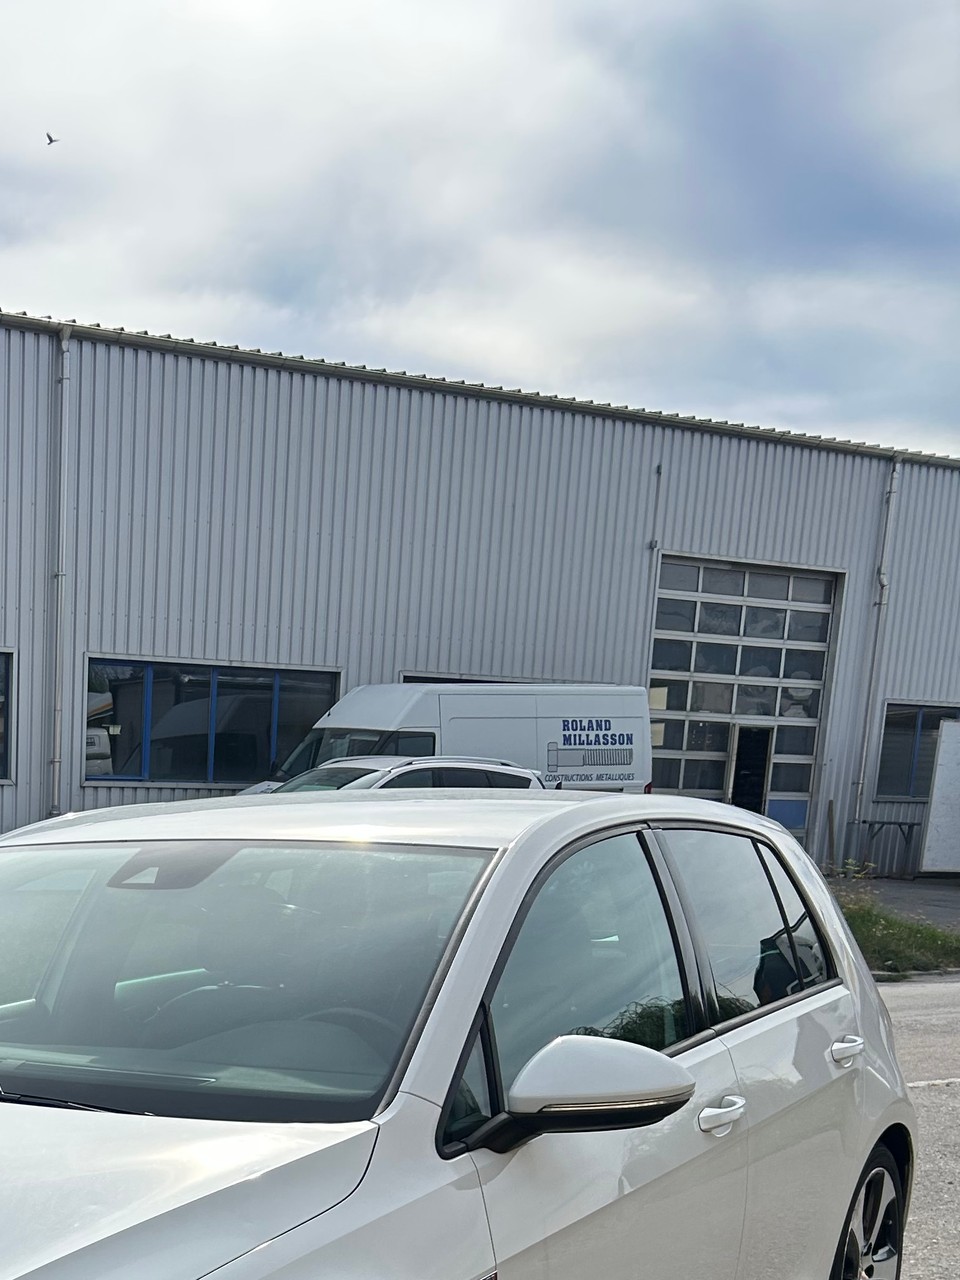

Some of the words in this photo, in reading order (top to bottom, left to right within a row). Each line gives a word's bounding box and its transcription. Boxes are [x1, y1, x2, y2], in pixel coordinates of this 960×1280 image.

[562, 720, 612, 732] ROLAND
[562, 733, 633, 746] MILLASSON
[545, 774, 594, 782] CONSTRUCTIONS
[596, 773, 635, 782] METALLIQUES
